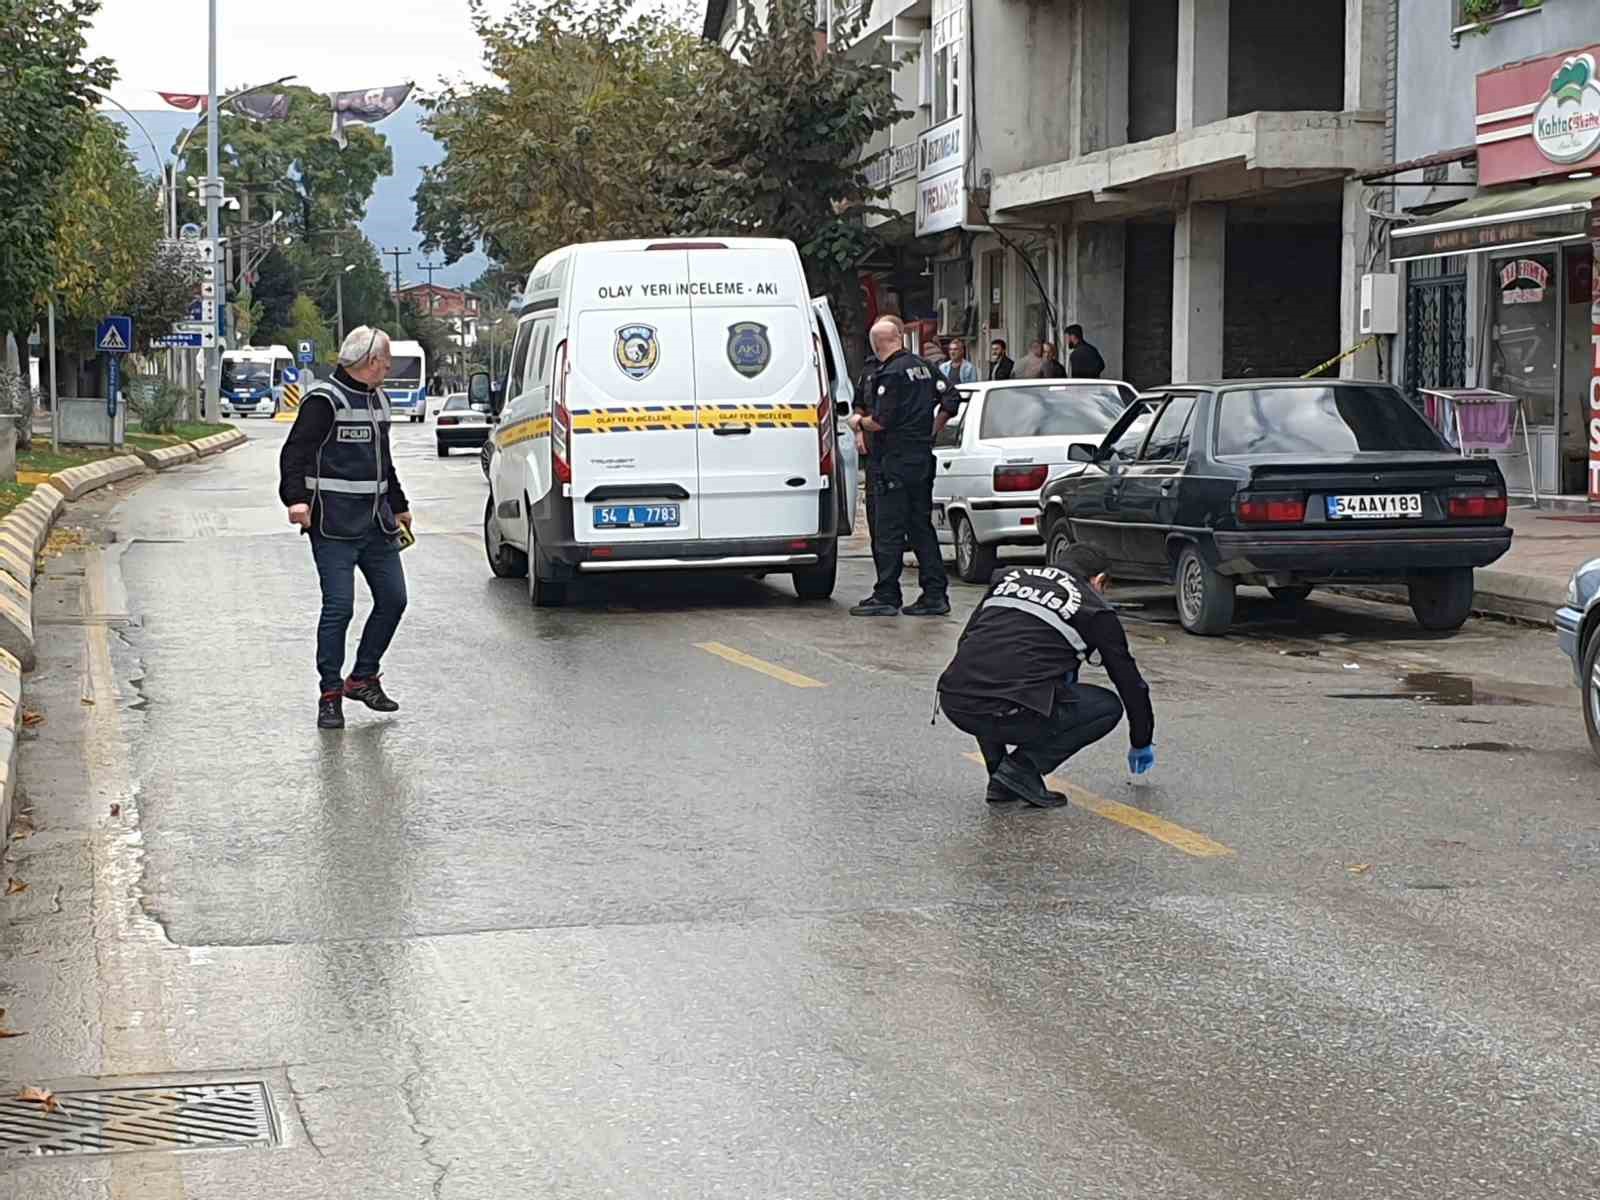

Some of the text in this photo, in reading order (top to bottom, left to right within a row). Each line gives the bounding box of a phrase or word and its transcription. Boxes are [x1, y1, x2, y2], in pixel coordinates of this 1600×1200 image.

[599, 286, 633, 299] OLAY
[601, 507, 677, 522] 54 A 7783
